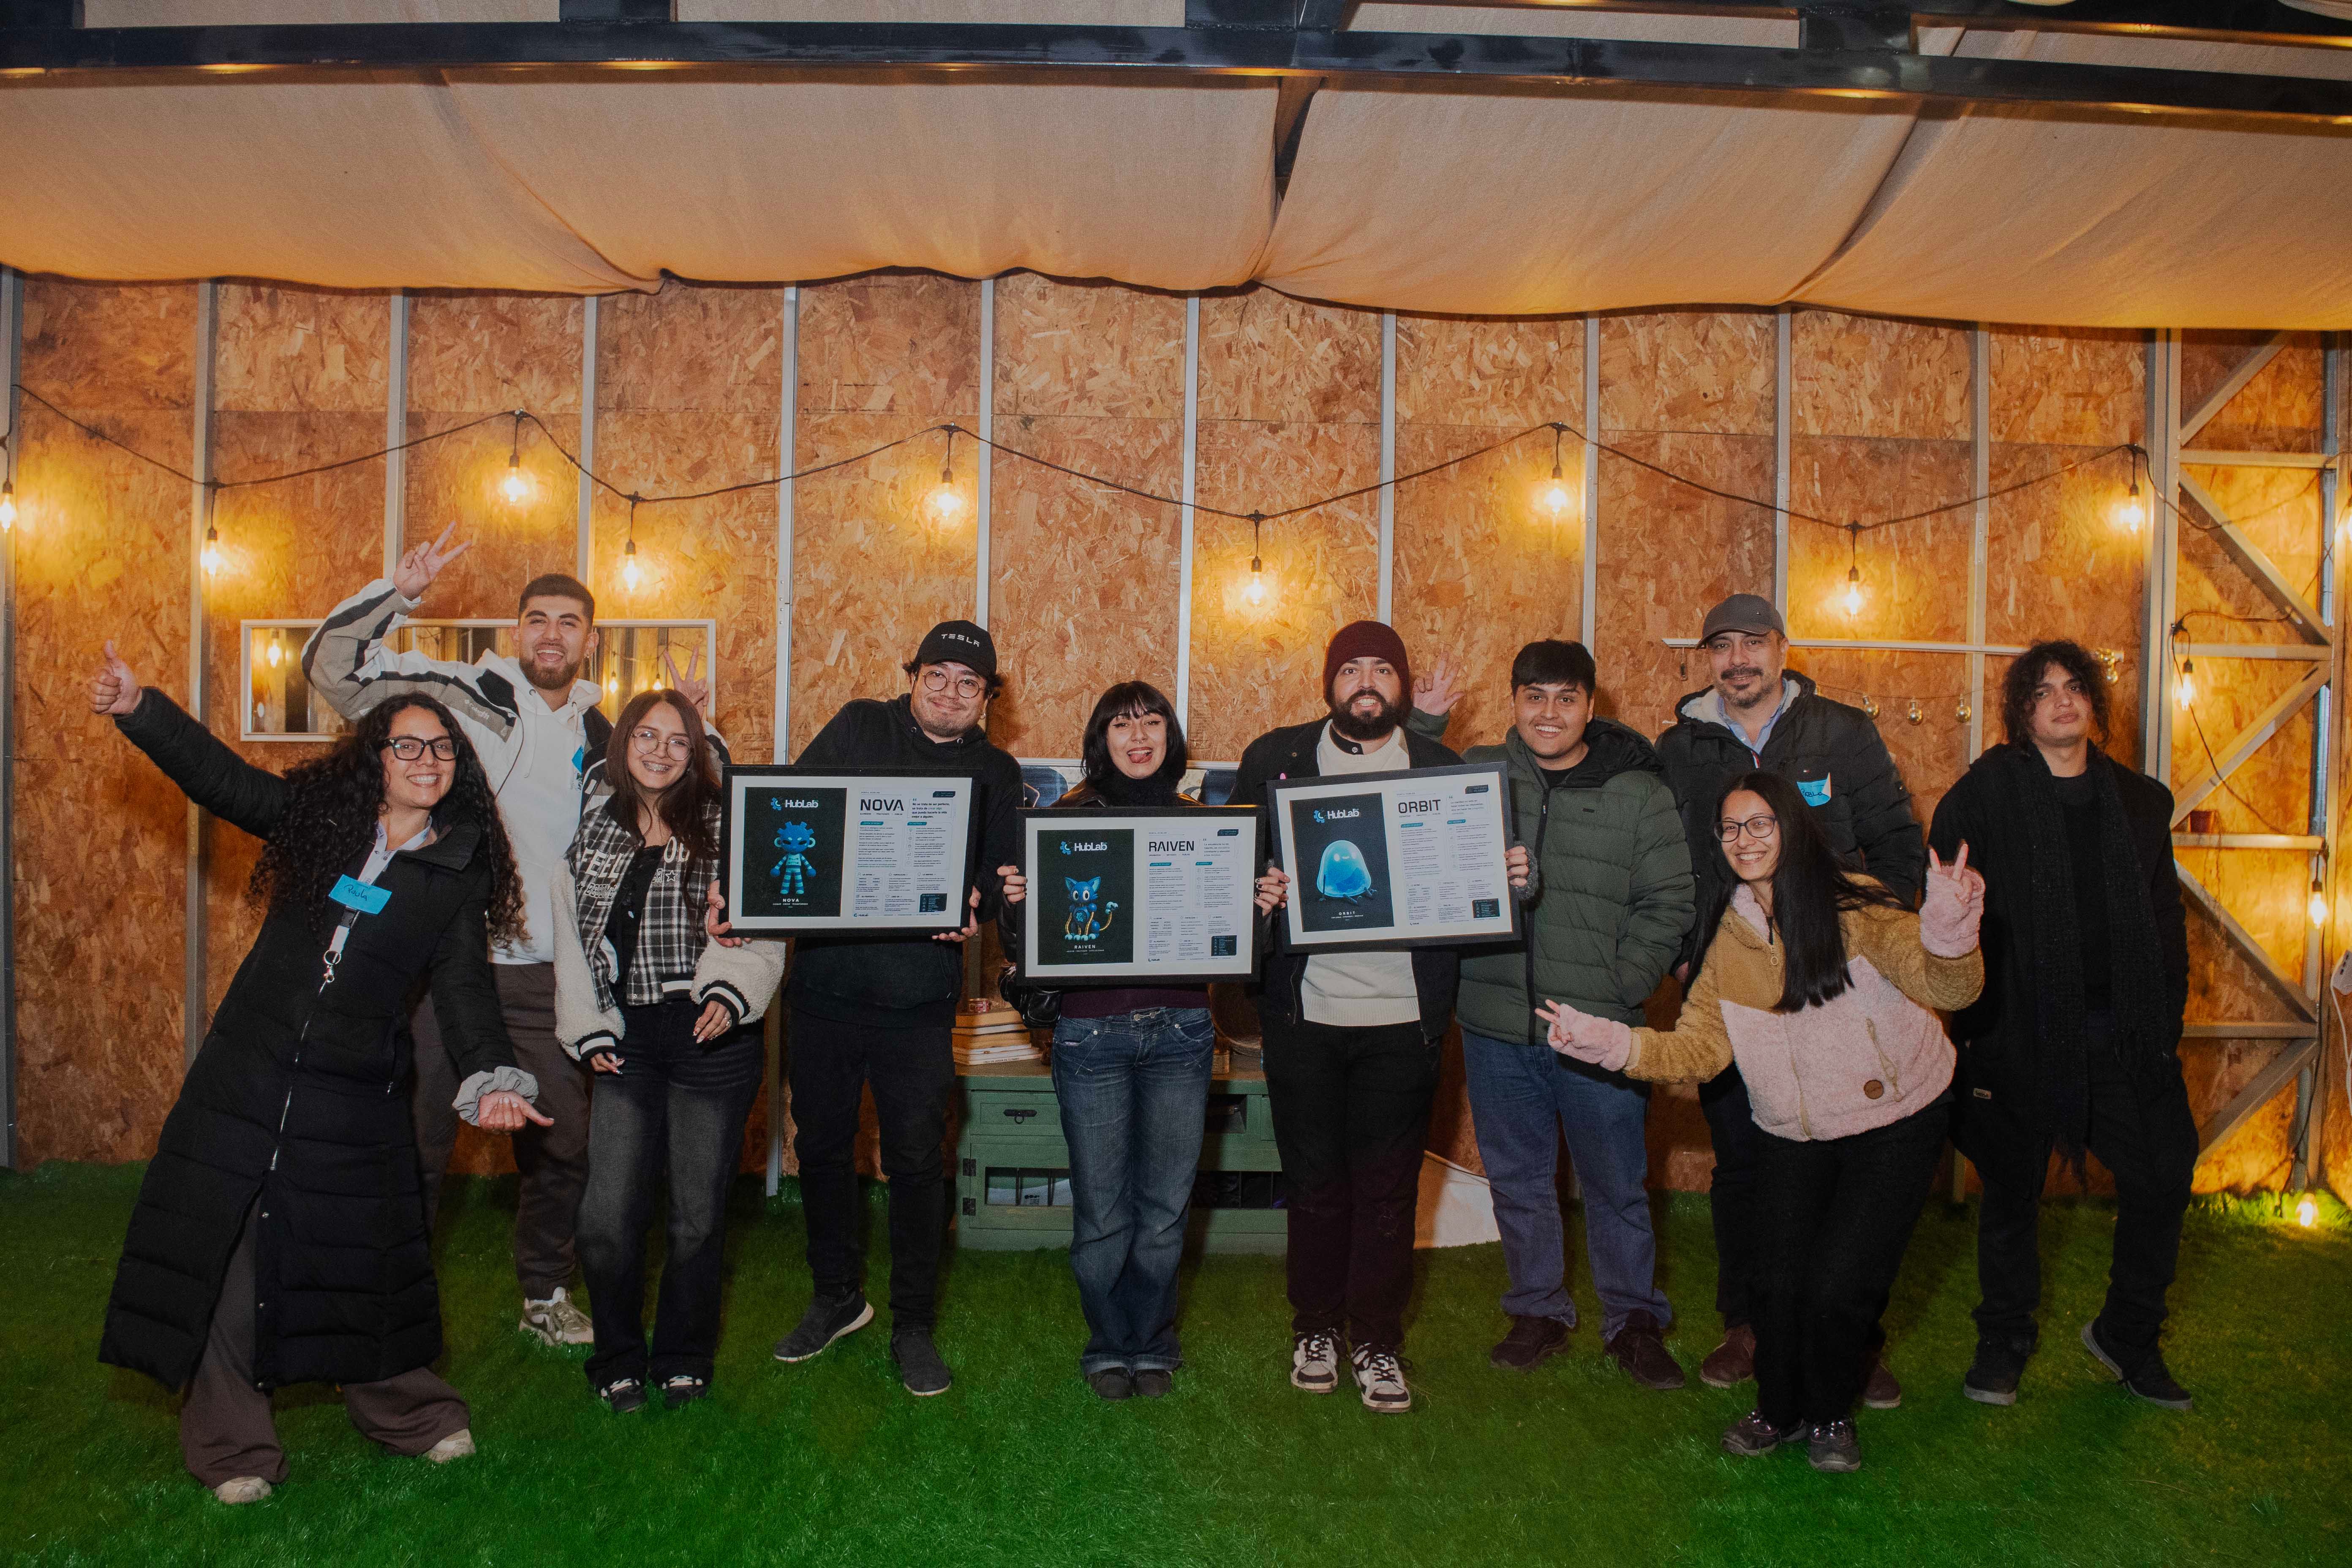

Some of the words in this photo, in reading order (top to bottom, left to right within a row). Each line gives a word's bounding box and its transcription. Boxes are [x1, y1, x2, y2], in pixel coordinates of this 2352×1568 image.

[941, 633, 980, 648] TESLA
[785, 799, 819, 808] HubLab
[860, 799, 904, 811] NOVA
[1398, 799, 1441, 814] ORBIT
[1327, 808, 1359, 819] HubLab
[1074, 842, 1108, 852] HubLab
[1149, 841, 1194, 852] RAIVEN
[344, 884, 368, 901] Paula
